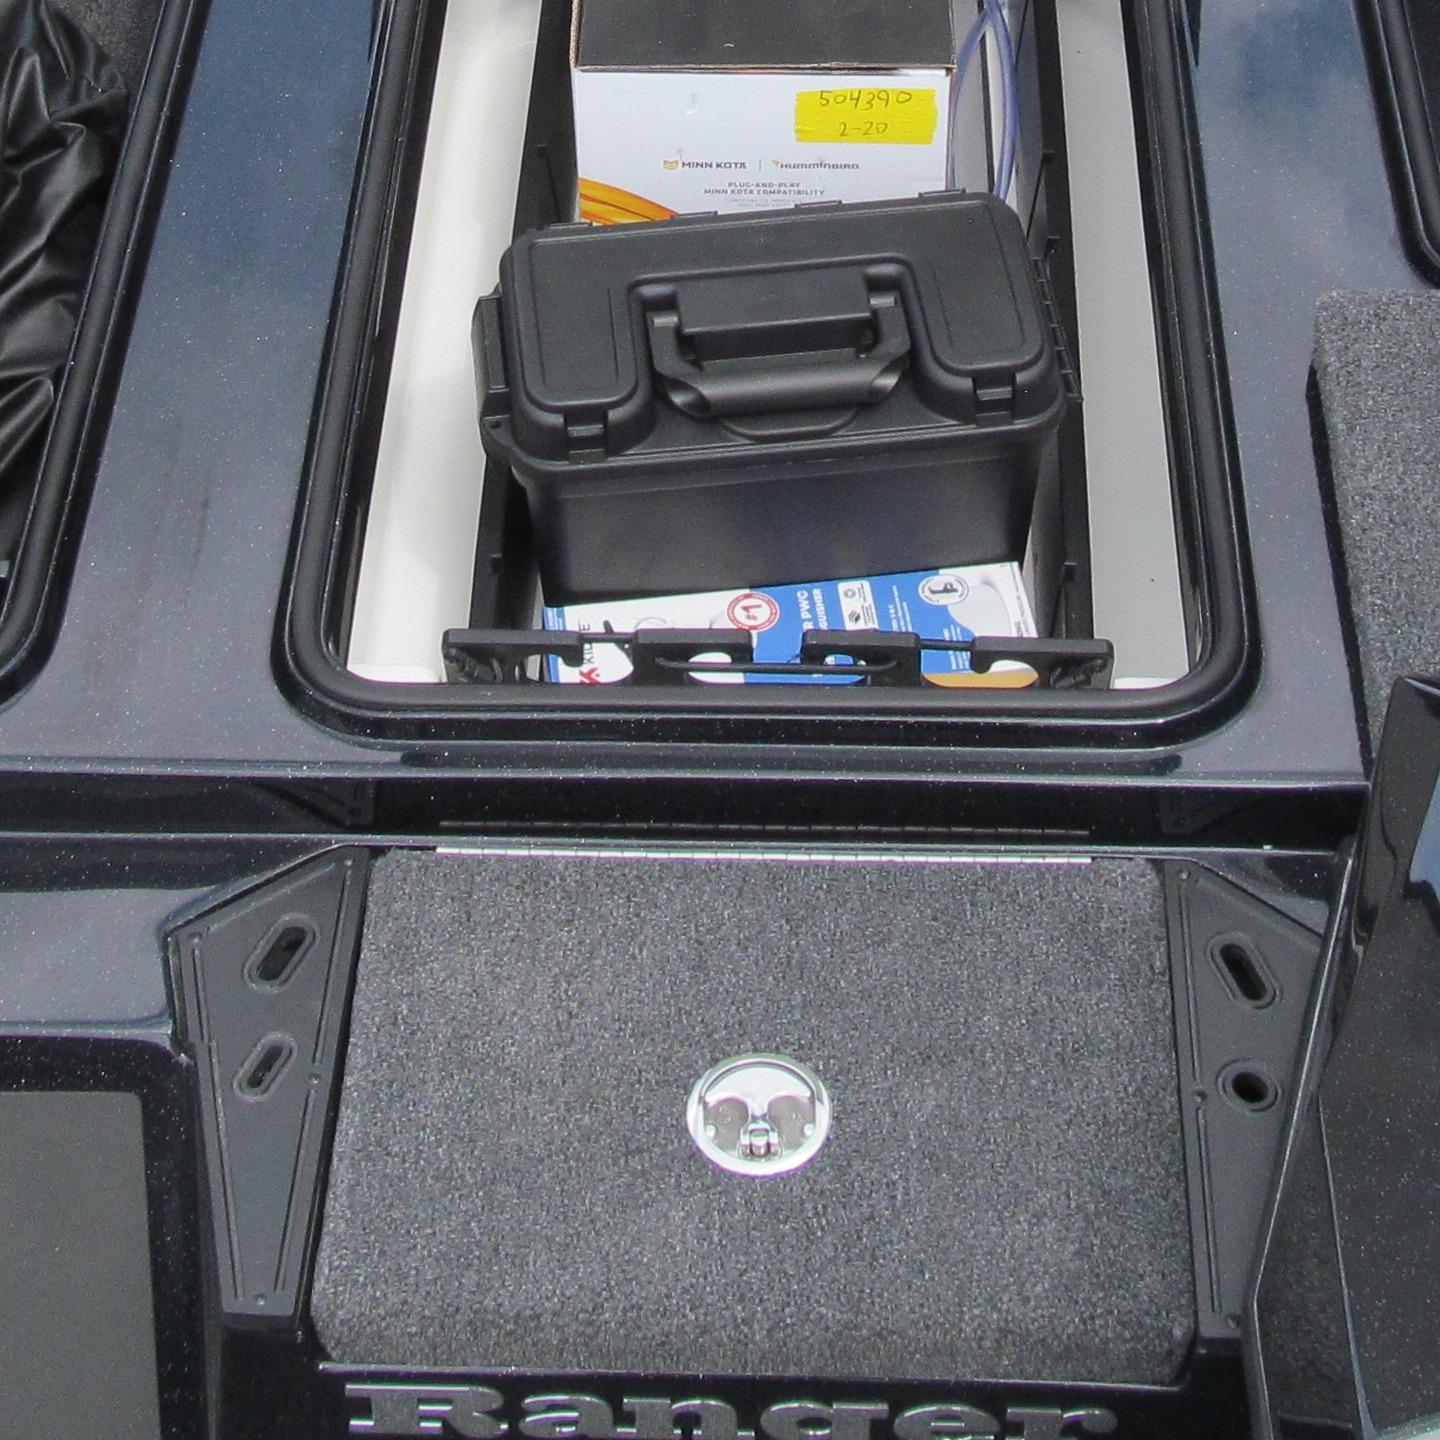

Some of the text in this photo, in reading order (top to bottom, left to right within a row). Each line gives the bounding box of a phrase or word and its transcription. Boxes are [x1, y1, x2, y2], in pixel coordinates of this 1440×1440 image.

[819, 89, 913, 111] 504390
[839, 120, 889, 137] 2-20
[681, 160, 747, 170] MINN KOTA
[727, 181, 801, 189] PLUG-AND-PLAY
[740, 604, 762, 622] #1
[796, 590, 812, 619] PWC
[578, 623, 594, 664] KIDE
